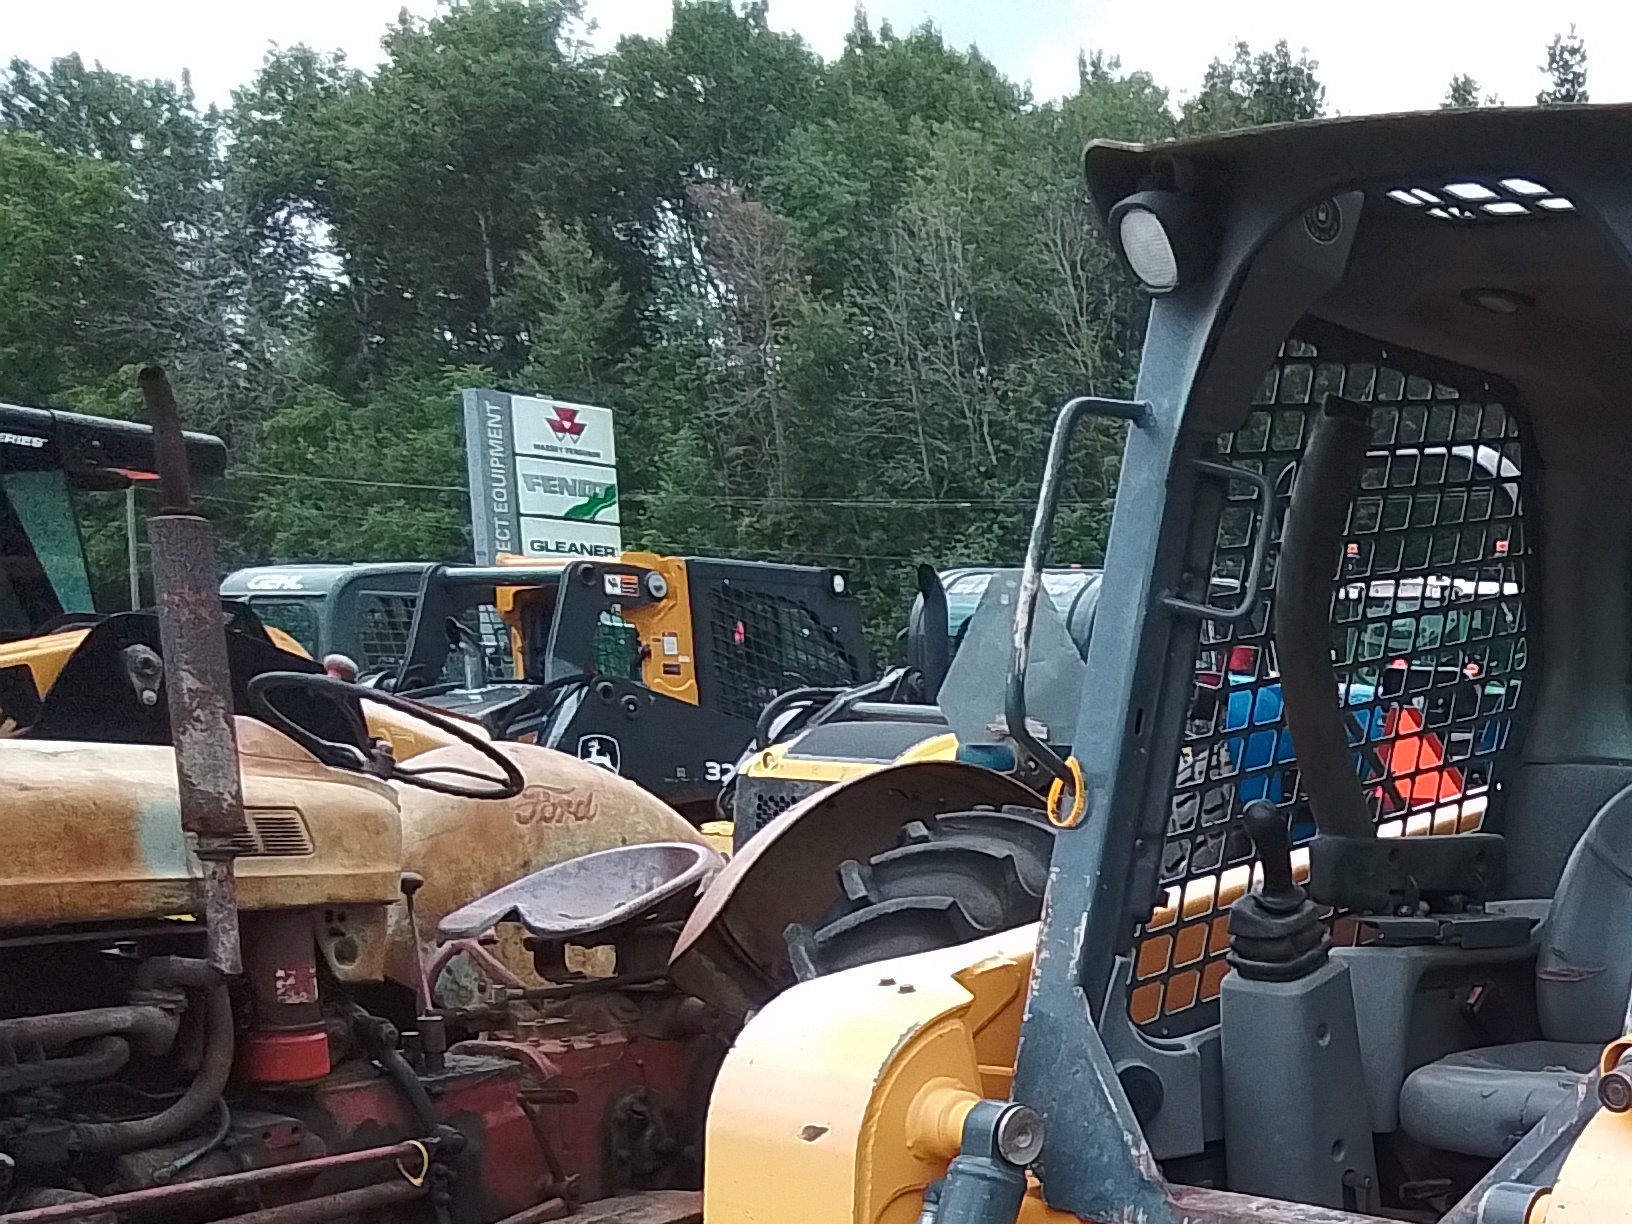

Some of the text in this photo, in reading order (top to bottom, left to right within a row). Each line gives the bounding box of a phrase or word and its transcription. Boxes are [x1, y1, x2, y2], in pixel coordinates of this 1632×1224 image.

[485, 400, 509, 513] EQUIPMENT
[530, 539, 616, 558] GLEANER
[514, 784, 598, 825] Ford
